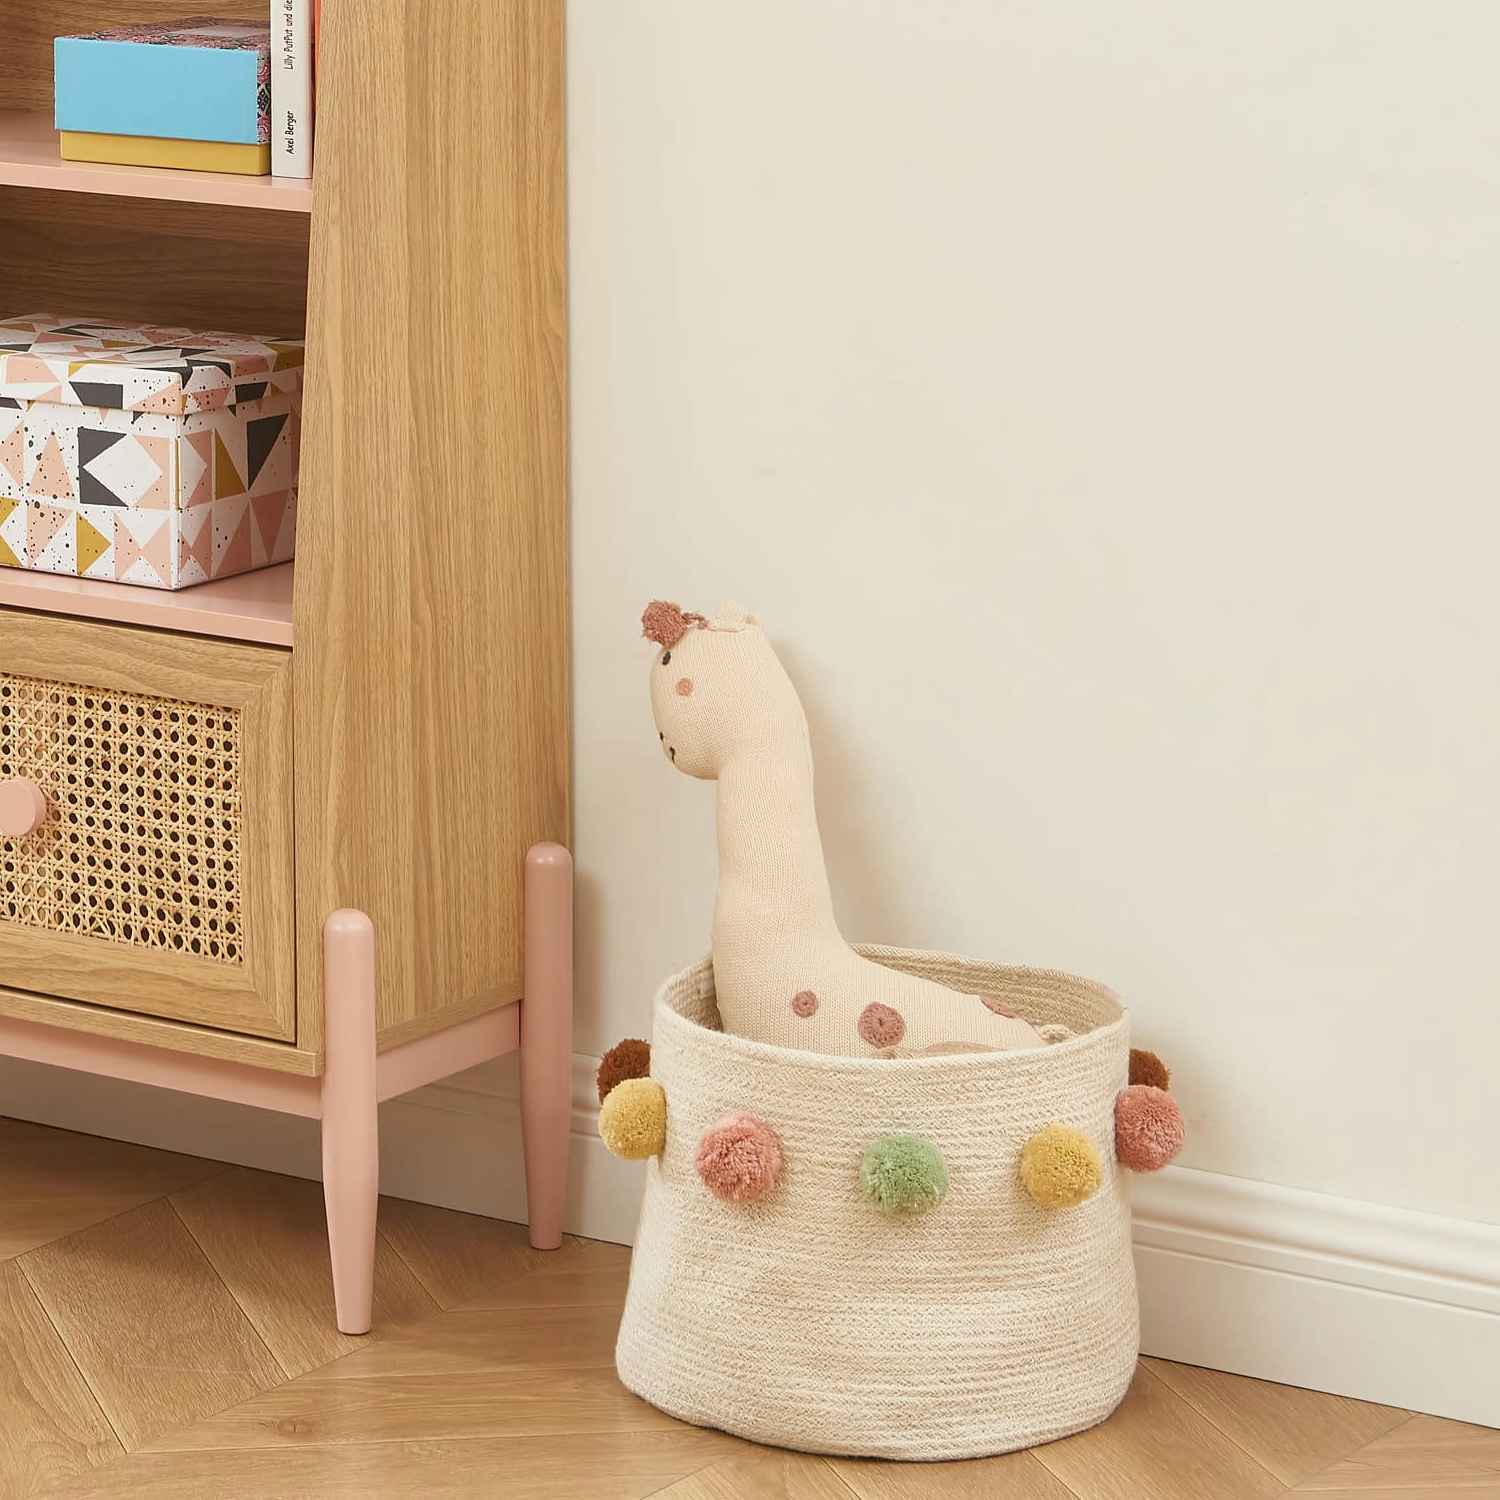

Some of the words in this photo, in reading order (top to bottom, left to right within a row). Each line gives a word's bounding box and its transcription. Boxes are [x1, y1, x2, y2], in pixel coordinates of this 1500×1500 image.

[284, 0, 293, 12] die
[284, 13, 293, 27] und
[283, 54, 295, 70] Lilly
[285, 111, 297, 136] Berger
[284, 137, 295, 155] Axel
